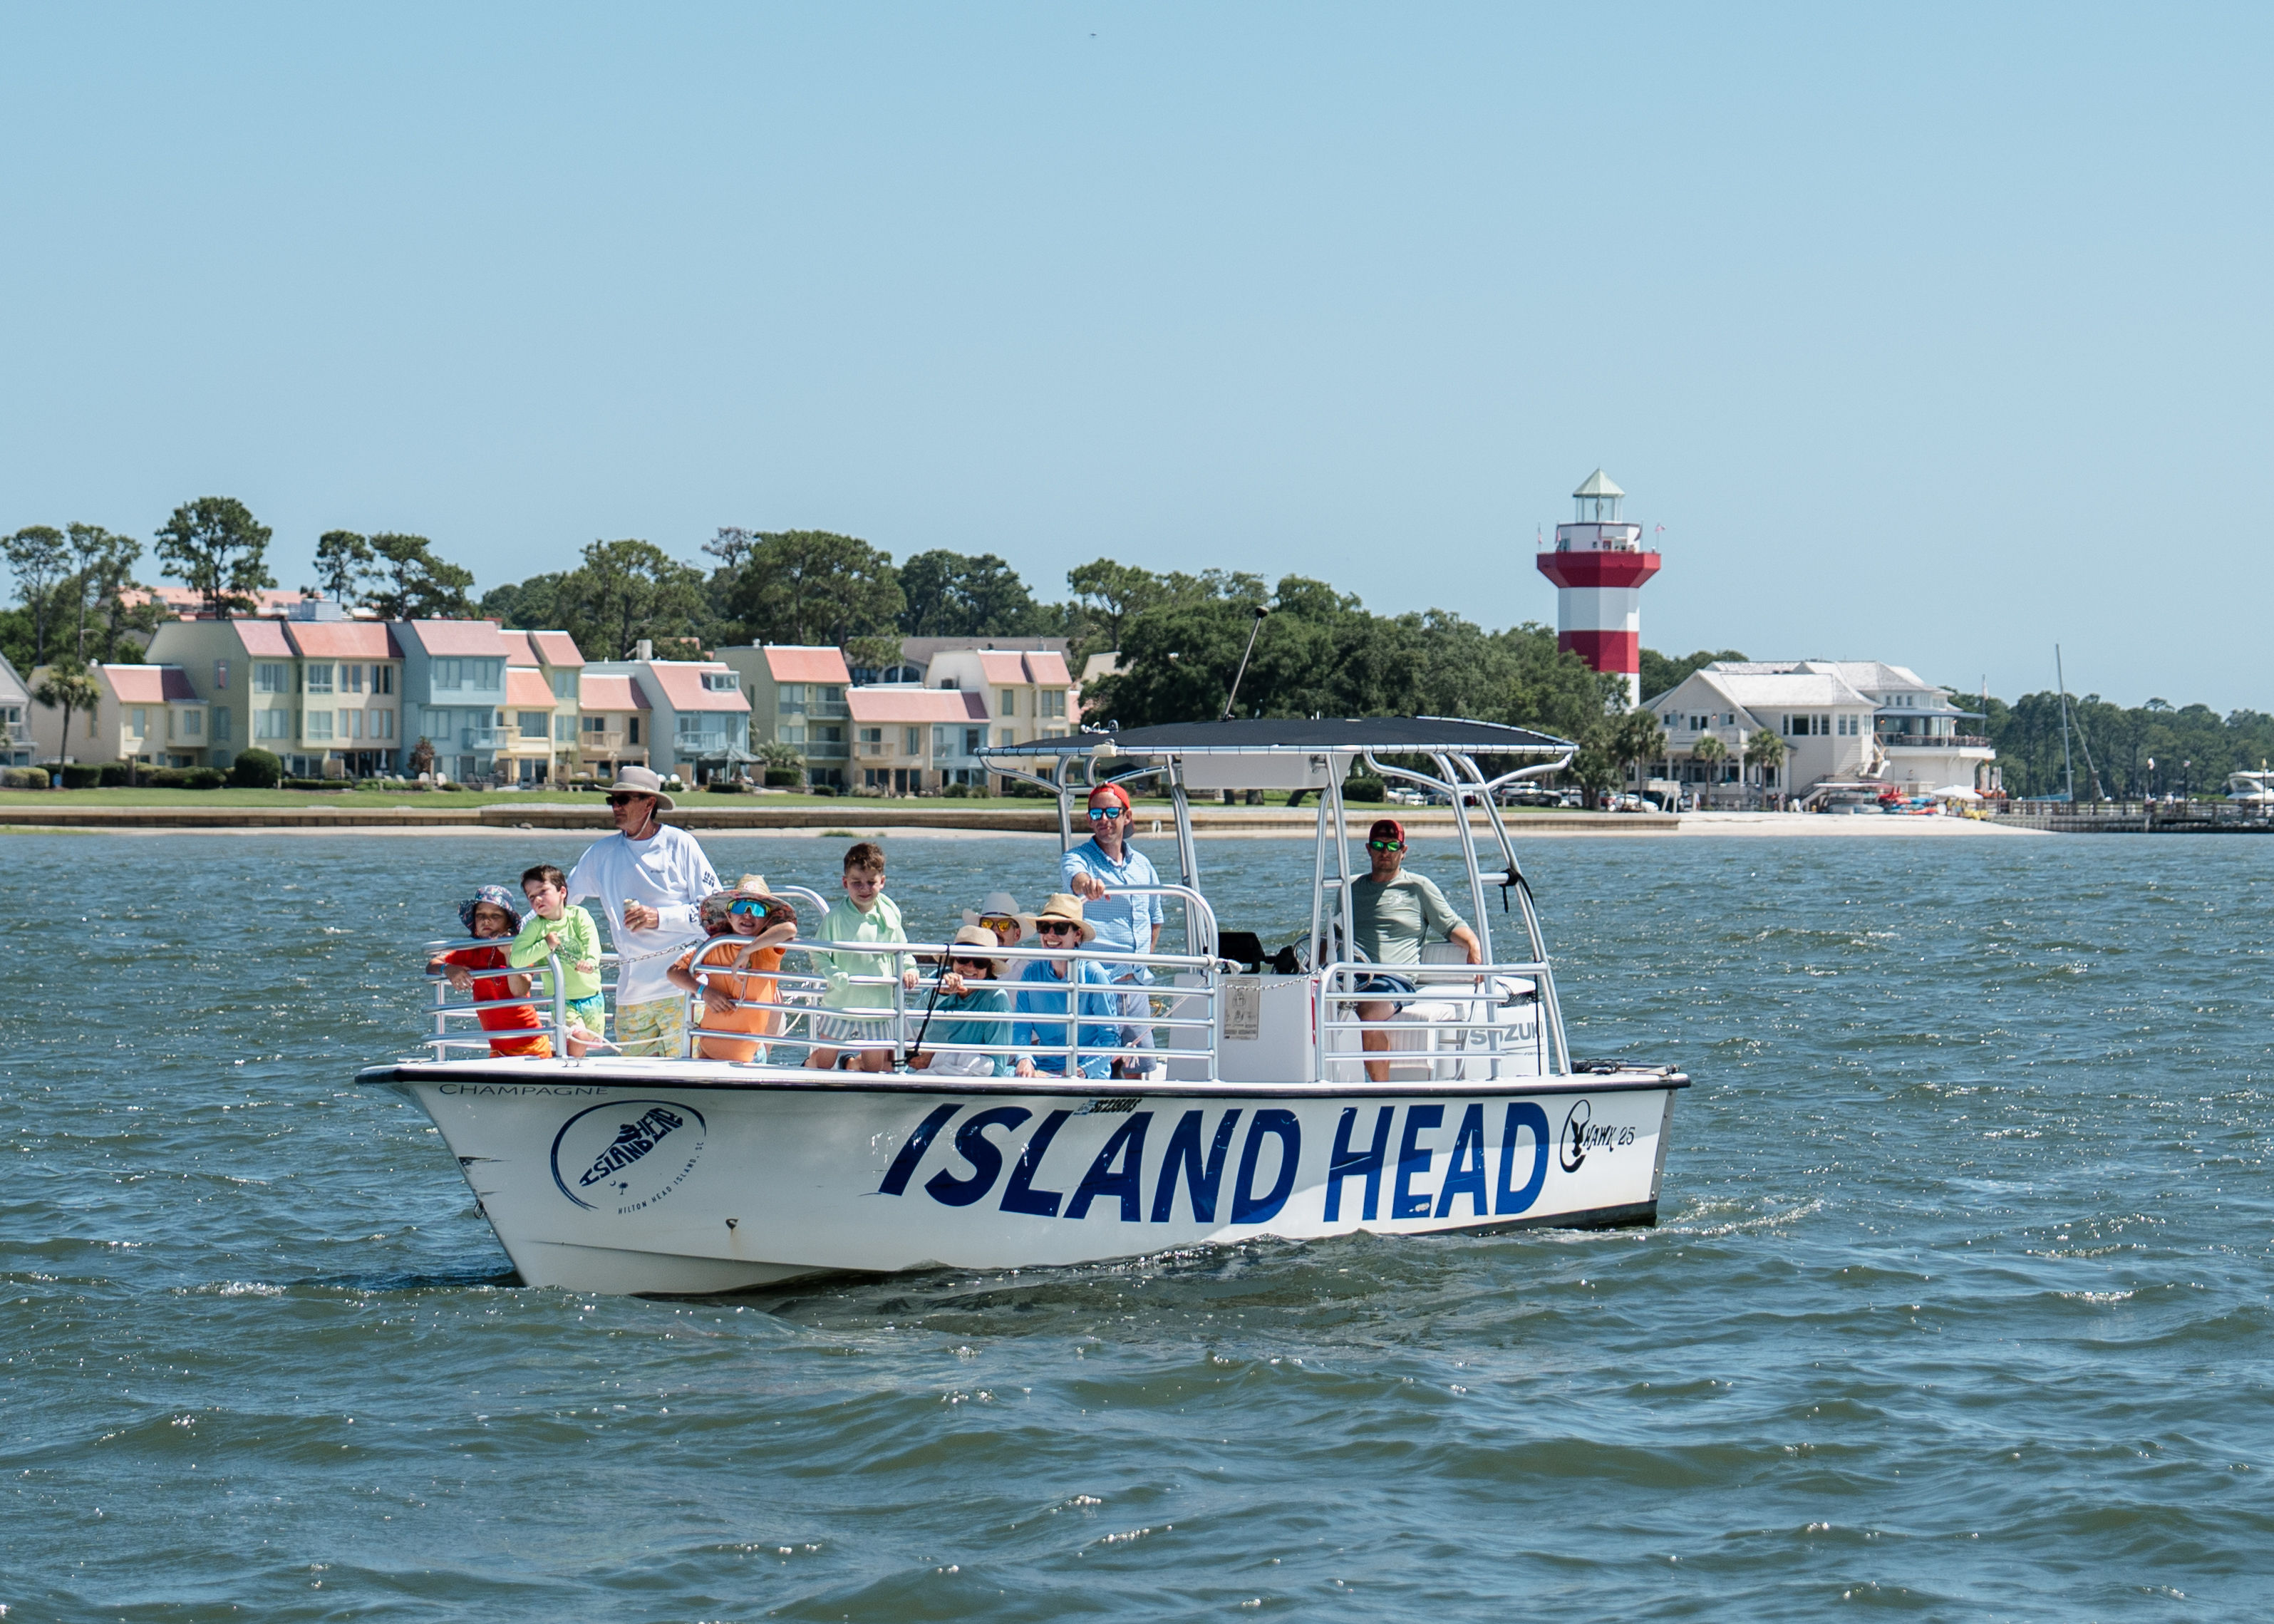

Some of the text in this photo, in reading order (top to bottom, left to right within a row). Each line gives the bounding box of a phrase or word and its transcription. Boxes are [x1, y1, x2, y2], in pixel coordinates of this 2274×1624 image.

[439, 1083, 609, 1095] CHAMPAGNE
[579, 1108, 683, 1186] ISLAND HEAD
[879, 1102, 1549, 1224] ISLAND HEAD
[1618, 1127, 1635, 1145] 25
[618, 1201, 647, 1214] HILTON
[651, 1186, 672, 1203] HEAD
[695, 1142, 704, 1150] SC
